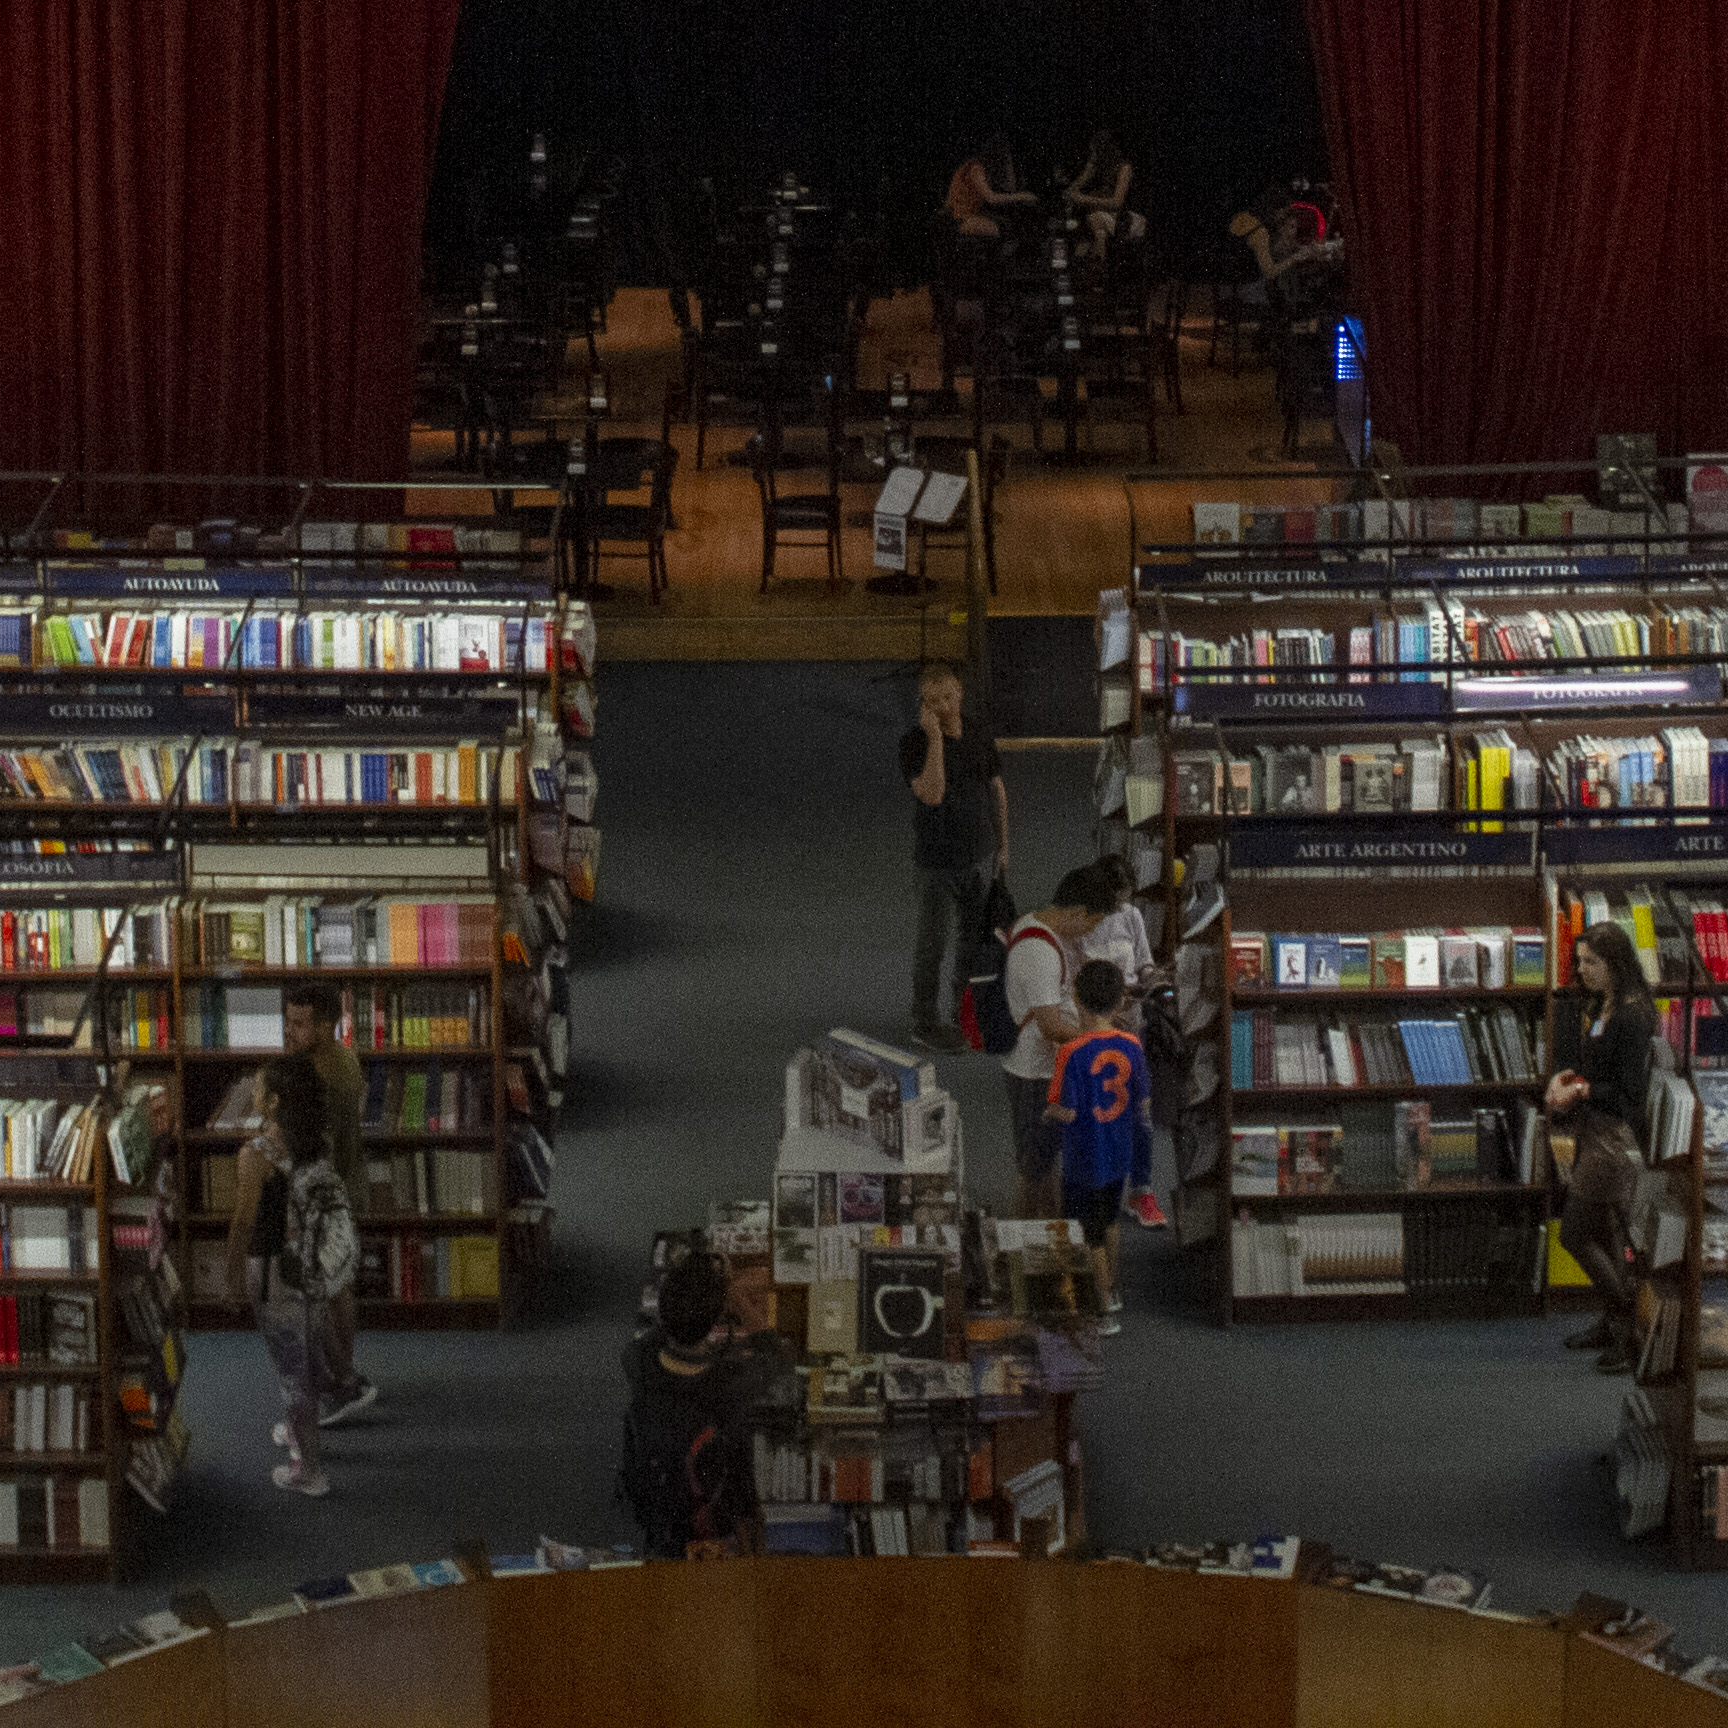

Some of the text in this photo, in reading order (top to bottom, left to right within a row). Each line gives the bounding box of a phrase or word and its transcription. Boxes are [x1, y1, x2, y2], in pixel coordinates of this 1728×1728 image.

[124, 576, 220, 592] AUTOAYUDA
[381, 579, 478, 594] AUTOAYUDA
[1254, 692, 1366, 708] FOTOGRAFIA
[49, 703, 154, 718] OCULTISMO
[345, 703, 423, 719] NEW AGE
[1297, 842, 1467, 858] ARTE ARGENTINO
[1675, 835, 1725, 851] ARTE
[1090, 1049, 1132, 1123] 3
